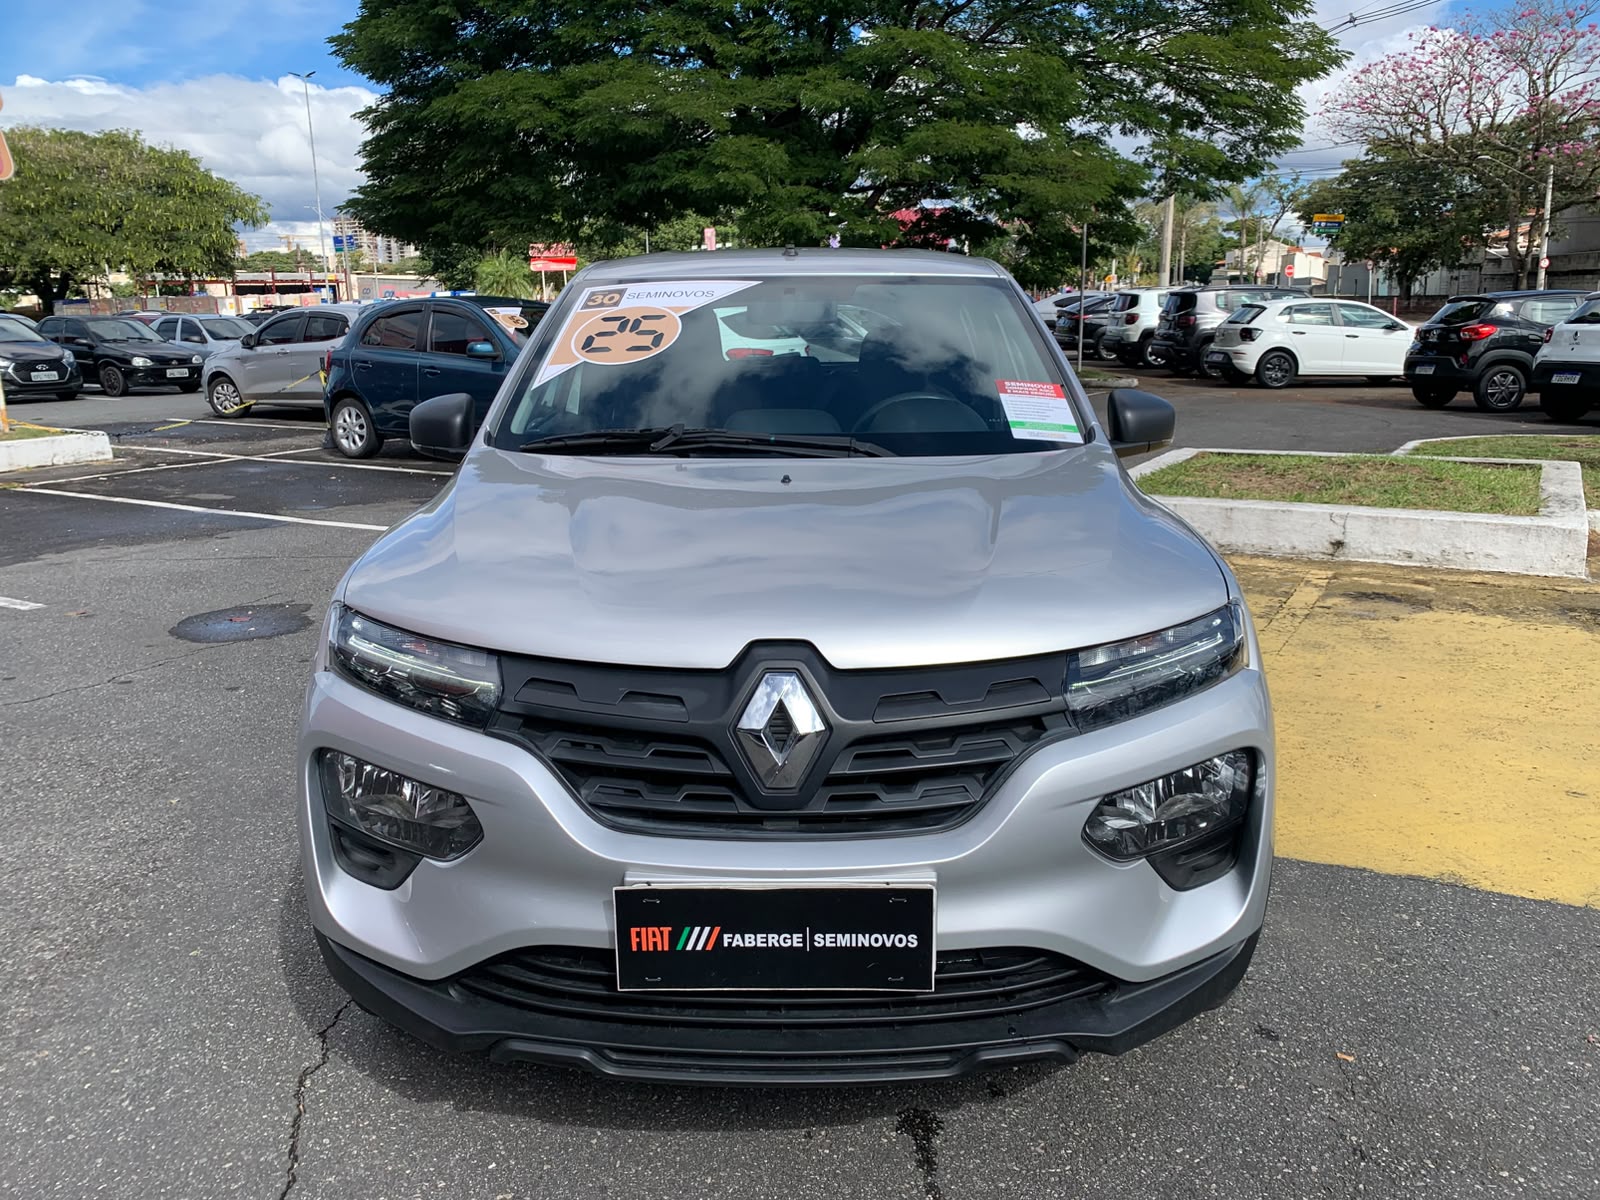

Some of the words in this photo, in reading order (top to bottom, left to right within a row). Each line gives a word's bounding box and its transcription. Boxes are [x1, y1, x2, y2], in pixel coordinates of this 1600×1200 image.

[587, 293, 620, 305] 30
[626, 290, 715, 300] SEMINOVOS
[581, 314, 667, 353] 25
[1004, 381, 1054, 390] SEMINOVO
[630, 926, 672, 951] FIAT
[722, 933, 803, 948] FABERGE
[813, 932, 918, 948] SEMINOVOS
